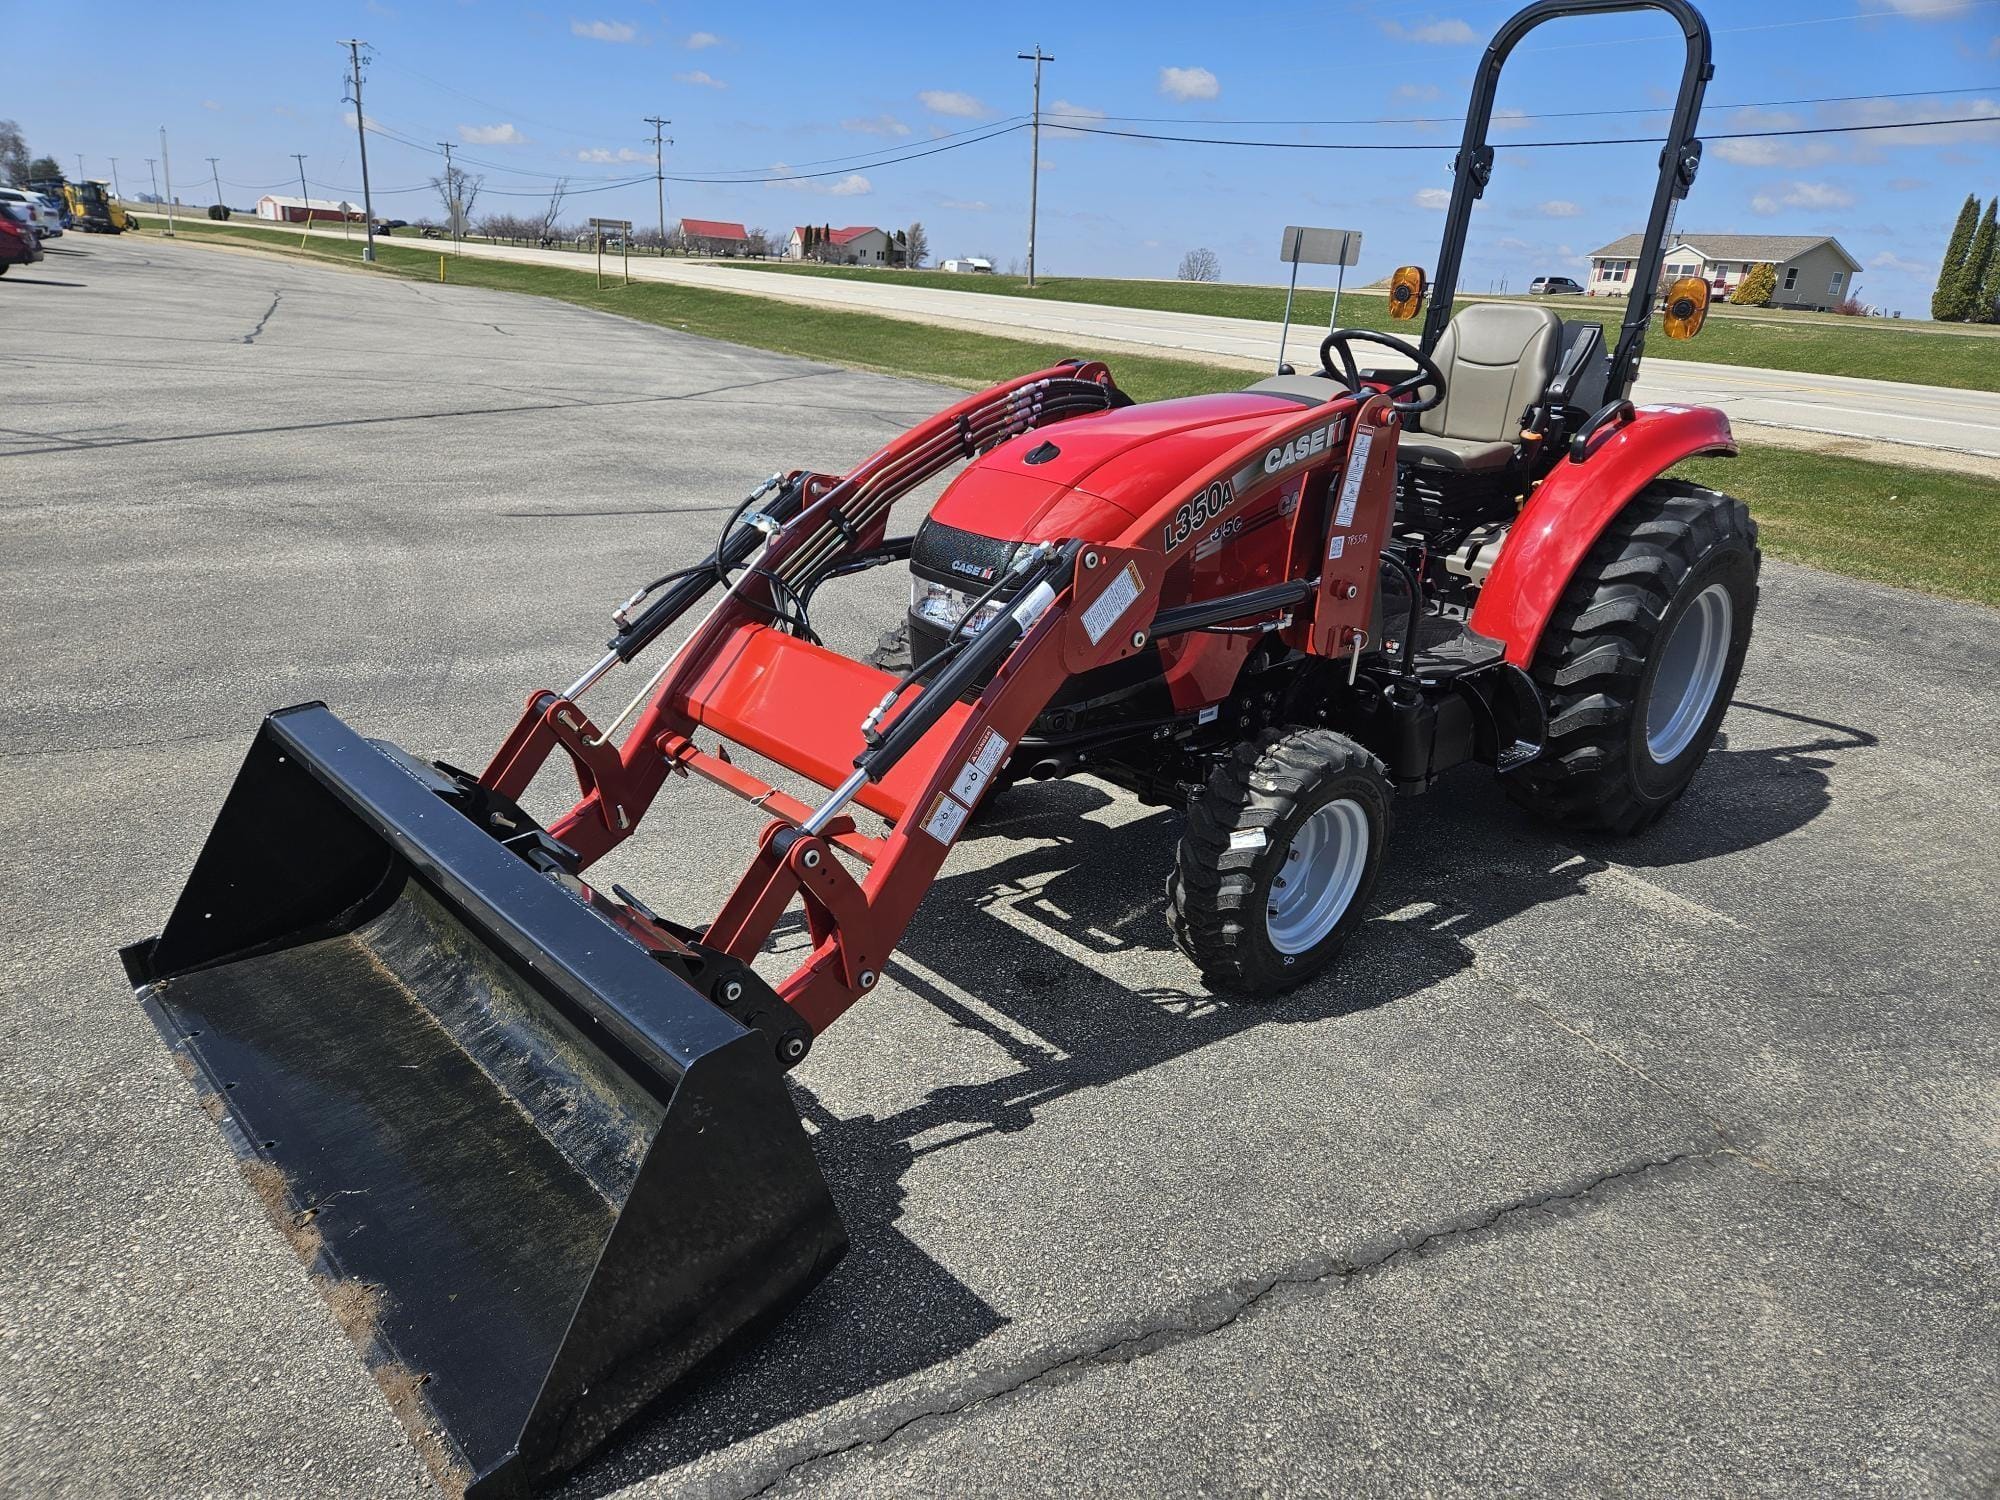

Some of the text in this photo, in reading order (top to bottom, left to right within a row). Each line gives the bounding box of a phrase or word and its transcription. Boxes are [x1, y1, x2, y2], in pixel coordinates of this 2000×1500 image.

[1264, 427, 1326, 474] CASE
[1164, 480, 1234, 554] L350A
[951, 560, 981, 577] CASE
[975, 730, 991, 756] DANGER
